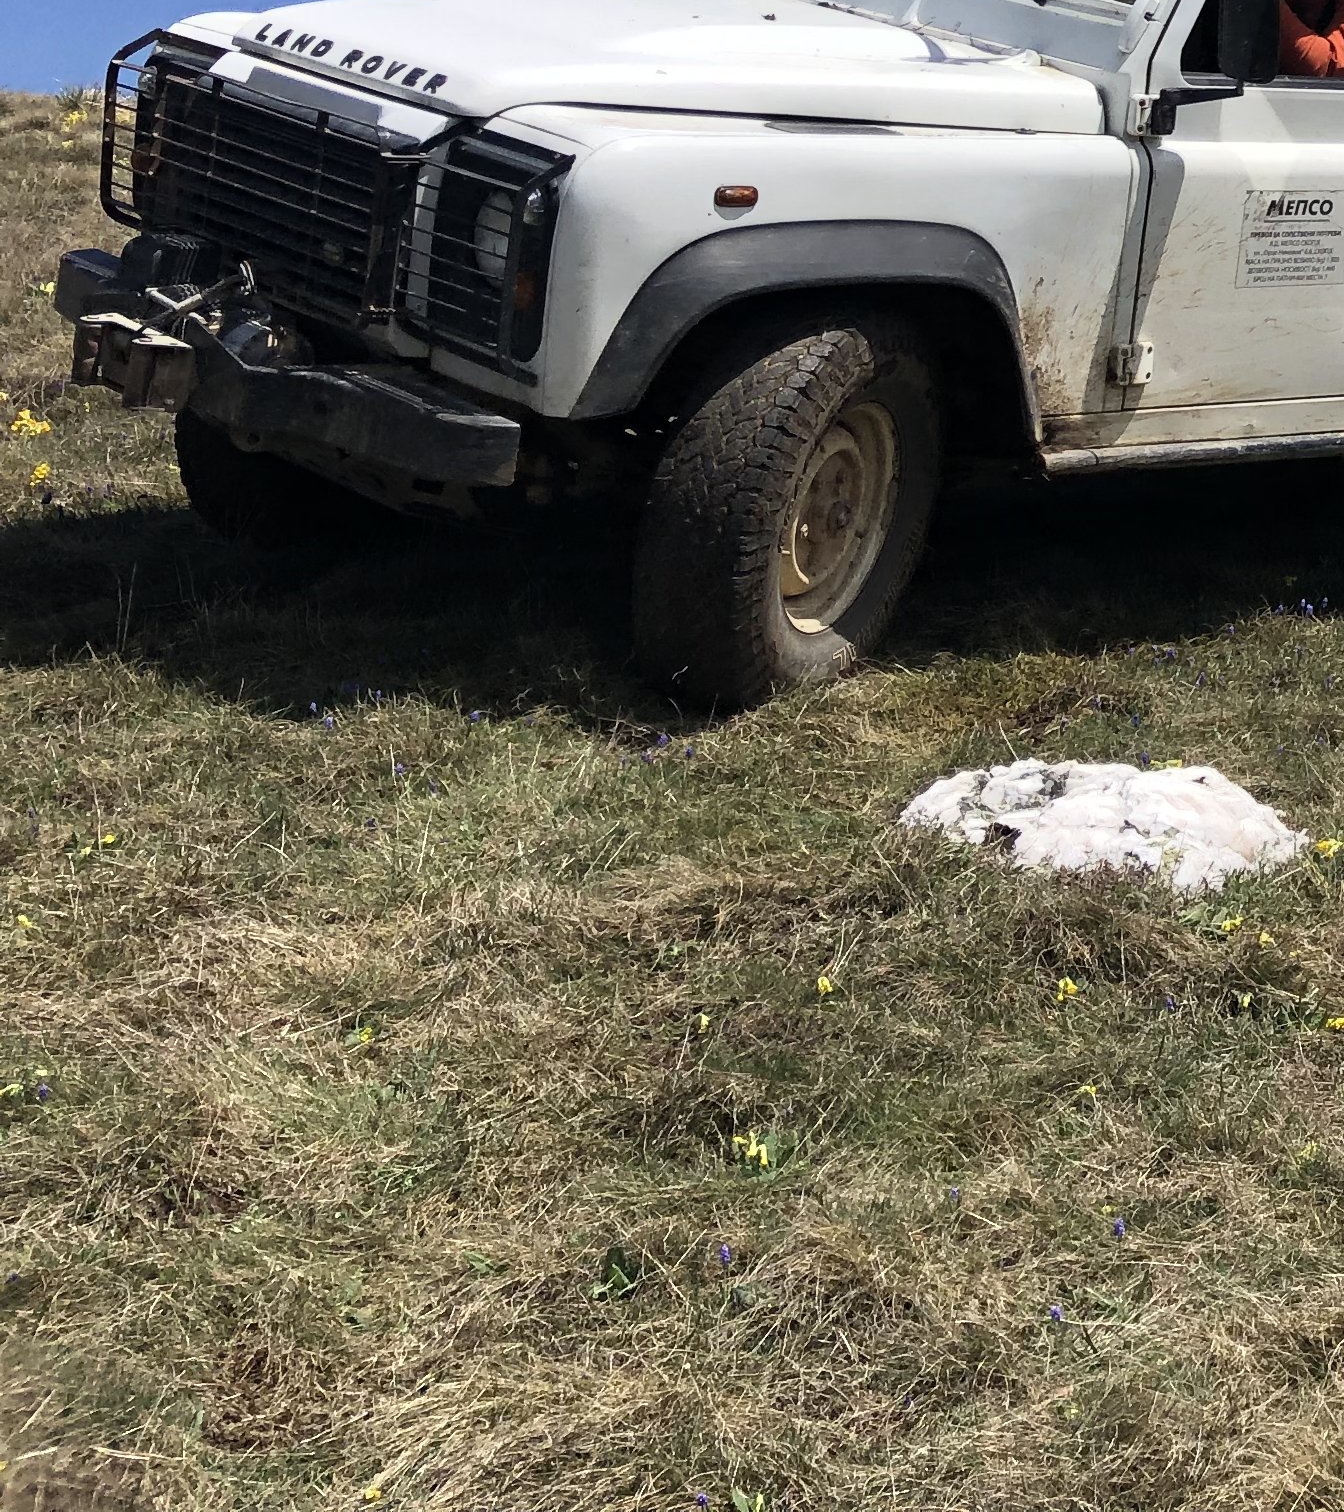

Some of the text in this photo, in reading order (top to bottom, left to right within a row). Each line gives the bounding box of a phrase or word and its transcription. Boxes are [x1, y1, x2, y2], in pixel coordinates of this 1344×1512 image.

[254, 23, 448, 94] LAND ROVER
[1266, 197, 1334, 217] МЕПСО
